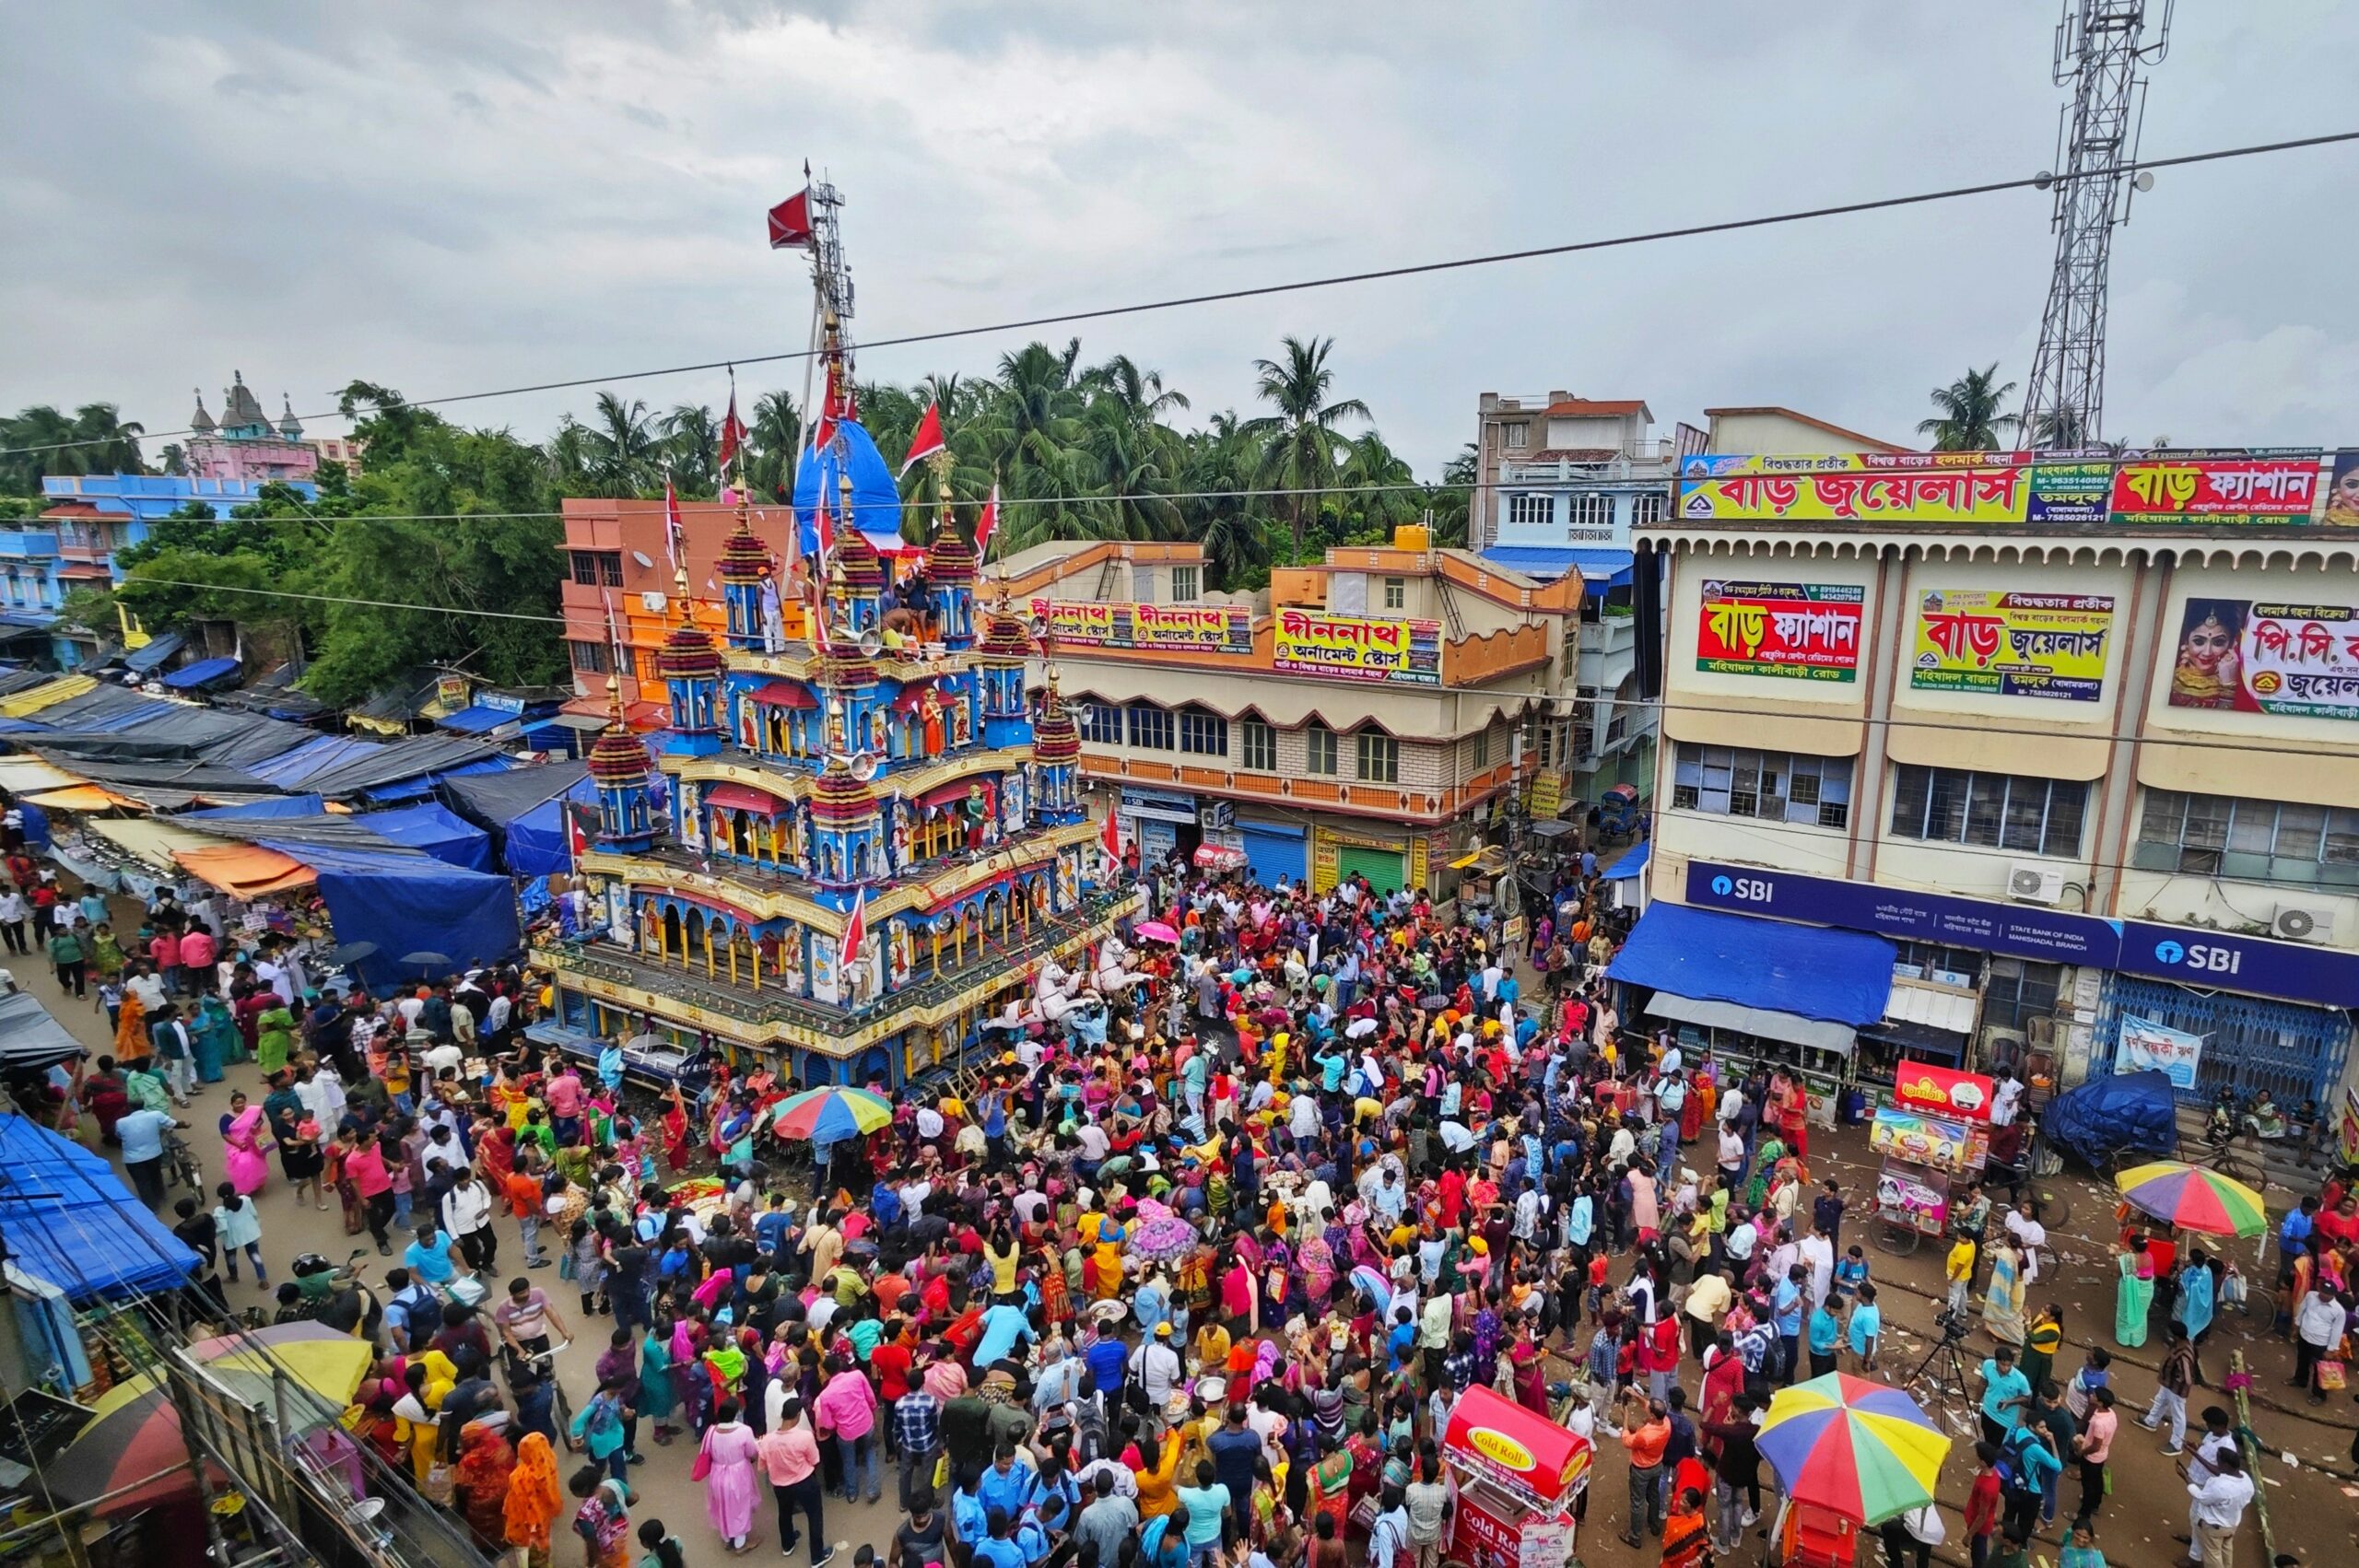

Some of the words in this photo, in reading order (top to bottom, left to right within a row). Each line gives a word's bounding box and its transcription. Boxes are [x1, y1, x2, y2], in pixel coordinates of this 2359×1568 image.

[1762, 456, 1813, 470] বিশুদ্ধতার
[1816, 455, 1849, 471] প্রতীক
[1935, 451, 1985, 466] হলমার্ক
[1985, 453, 2013, 465] গহনা
[2081, 463, 2111, 476] বাজার
[1714, 471, 1802, 515] বাড়
[1809, 467, 2021, 521] জুয়েলার্স
[2123, 462, 2203, 511] বাড়
[2205, 466, 2316, 501] ফ্যাশান
[2036, 493, 2104, 506] তমলুক
[2256, 515, 2292, 524] রোড
[2008, 594, 2069, 608] বিশুদ্ধতার
[2072, 597, 2113, 611] প্রতীক
[1137, 604, 1222, 628] দীননাথ
[2057, 614, 2088, 625] হলমার্ক
[2090, 616, 2108, 626] গহনা
[2258, 604, 2289, 617] হলমার্ক
[2290, 607, 2312, 618] গহনা
[2314, 607, 2350, 620] বিক্রেতা
[1279, 611, 1402, 648] দীননাথ
[1705, 599, 1769, 659] বাড়
[1771, 607, 1860, 650] ফ্যাশান
[1921, 609, 2006, 668] বাড়
[2008, 627, 2109, 663] জুয়েলার্স
[2252, 619, 2339, 665] পি.সি.
[1293, 644, 1357, 662] অর্নামেন্ট
[1813, 668, 1841, 679] রোড
[1966, 673, 2001, 685] বাজার
[2010, 673, 2050, 688] তমলুক
[1132, 798, 1144, 807] SBI
[1144, 836, 1161, 844] Service
[1734, 878, 1773, 903] SBI
[2008, 933, 2055, 947] MAHISHADAL
[2055, 941, 2087, 952] BRANCH
[2032, 928, 2052, 937] BANK
[2053, 930, 2063, 939] OF
[2063, 933, 2084, 942] INDIA
[2187, 944, 2241, 975] SBI
[2177, 1046, 2195, 1059] ঋণ
[1473, 1432, 1499, 1451] Cold
[1499, 1445, 1523, 1465] Roll
[1462, 1507, 1495, 1538] Cold
[1497, 1529, 1519, 1553] Ro
